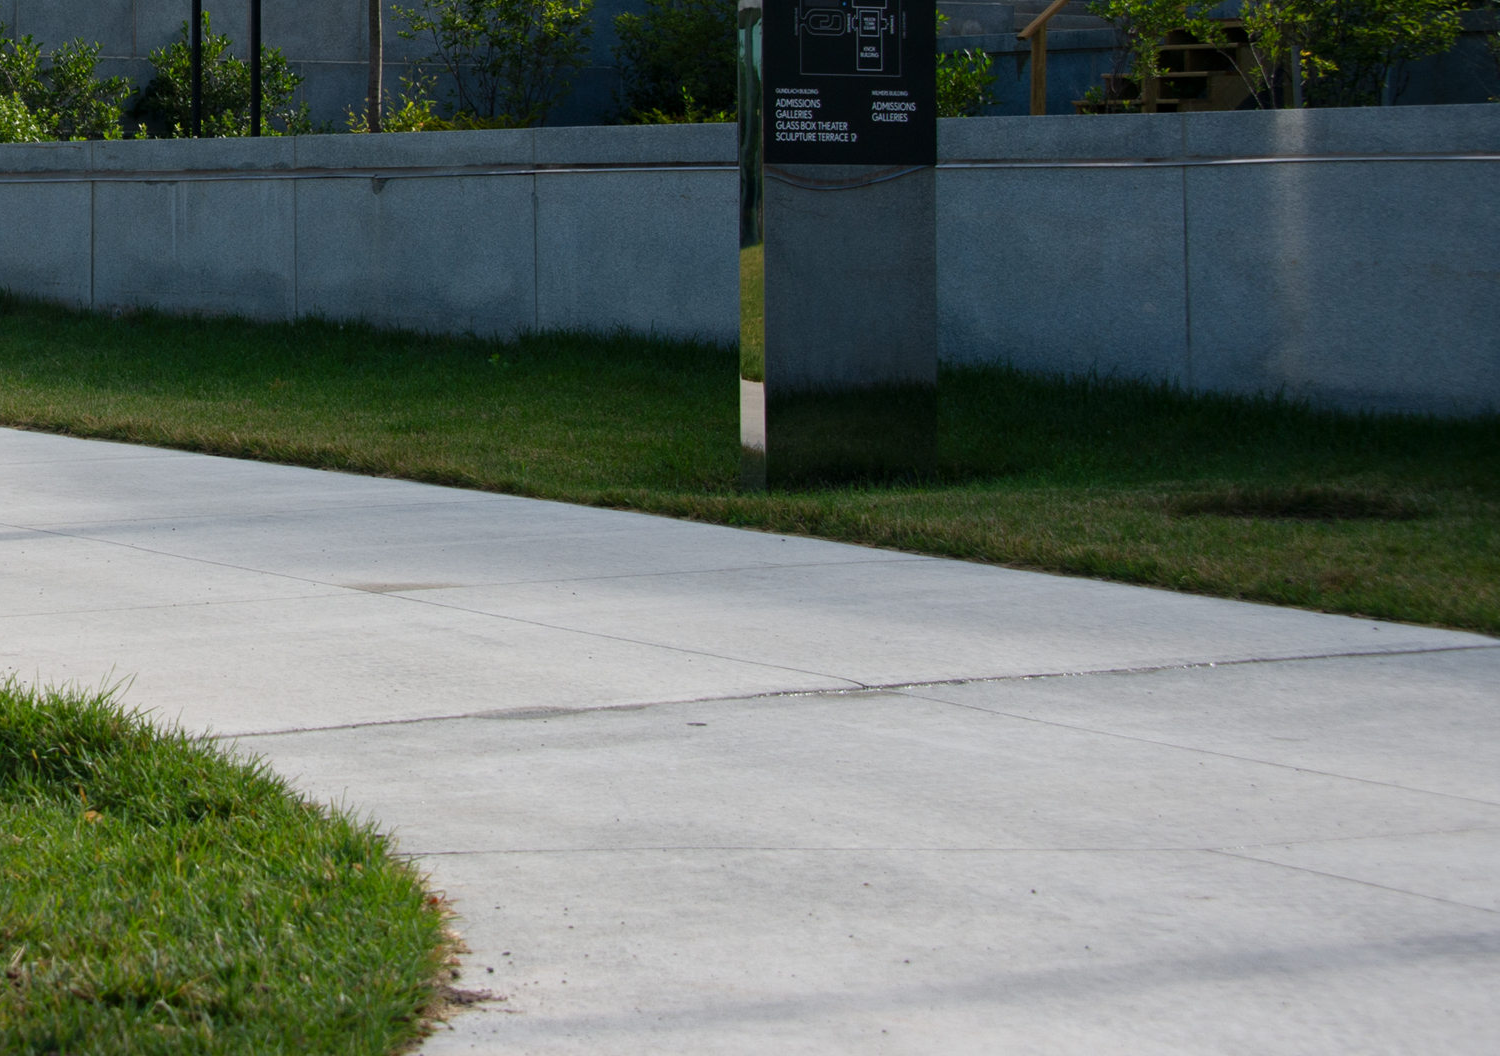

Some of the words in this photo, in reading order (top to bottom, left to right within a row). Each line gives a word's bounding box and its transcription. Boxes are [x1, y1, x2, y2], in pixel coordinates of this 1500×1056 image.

[775, 98, 821, 108] ADMISSIONS
[871, 101, 916, 111] ADMISSIONS
[775, 109, 813, 119] GALLERIES
[871, 112, 908, 122] GALLERIES
[775, 120, 800, 130] GLASS
[800, 121, 817, 131] BOX
[818, 121, 848, 131] THEATER
[775, 132, 817, 142] SCULPTURE
[818, 132, 849, 142] TERRACE
